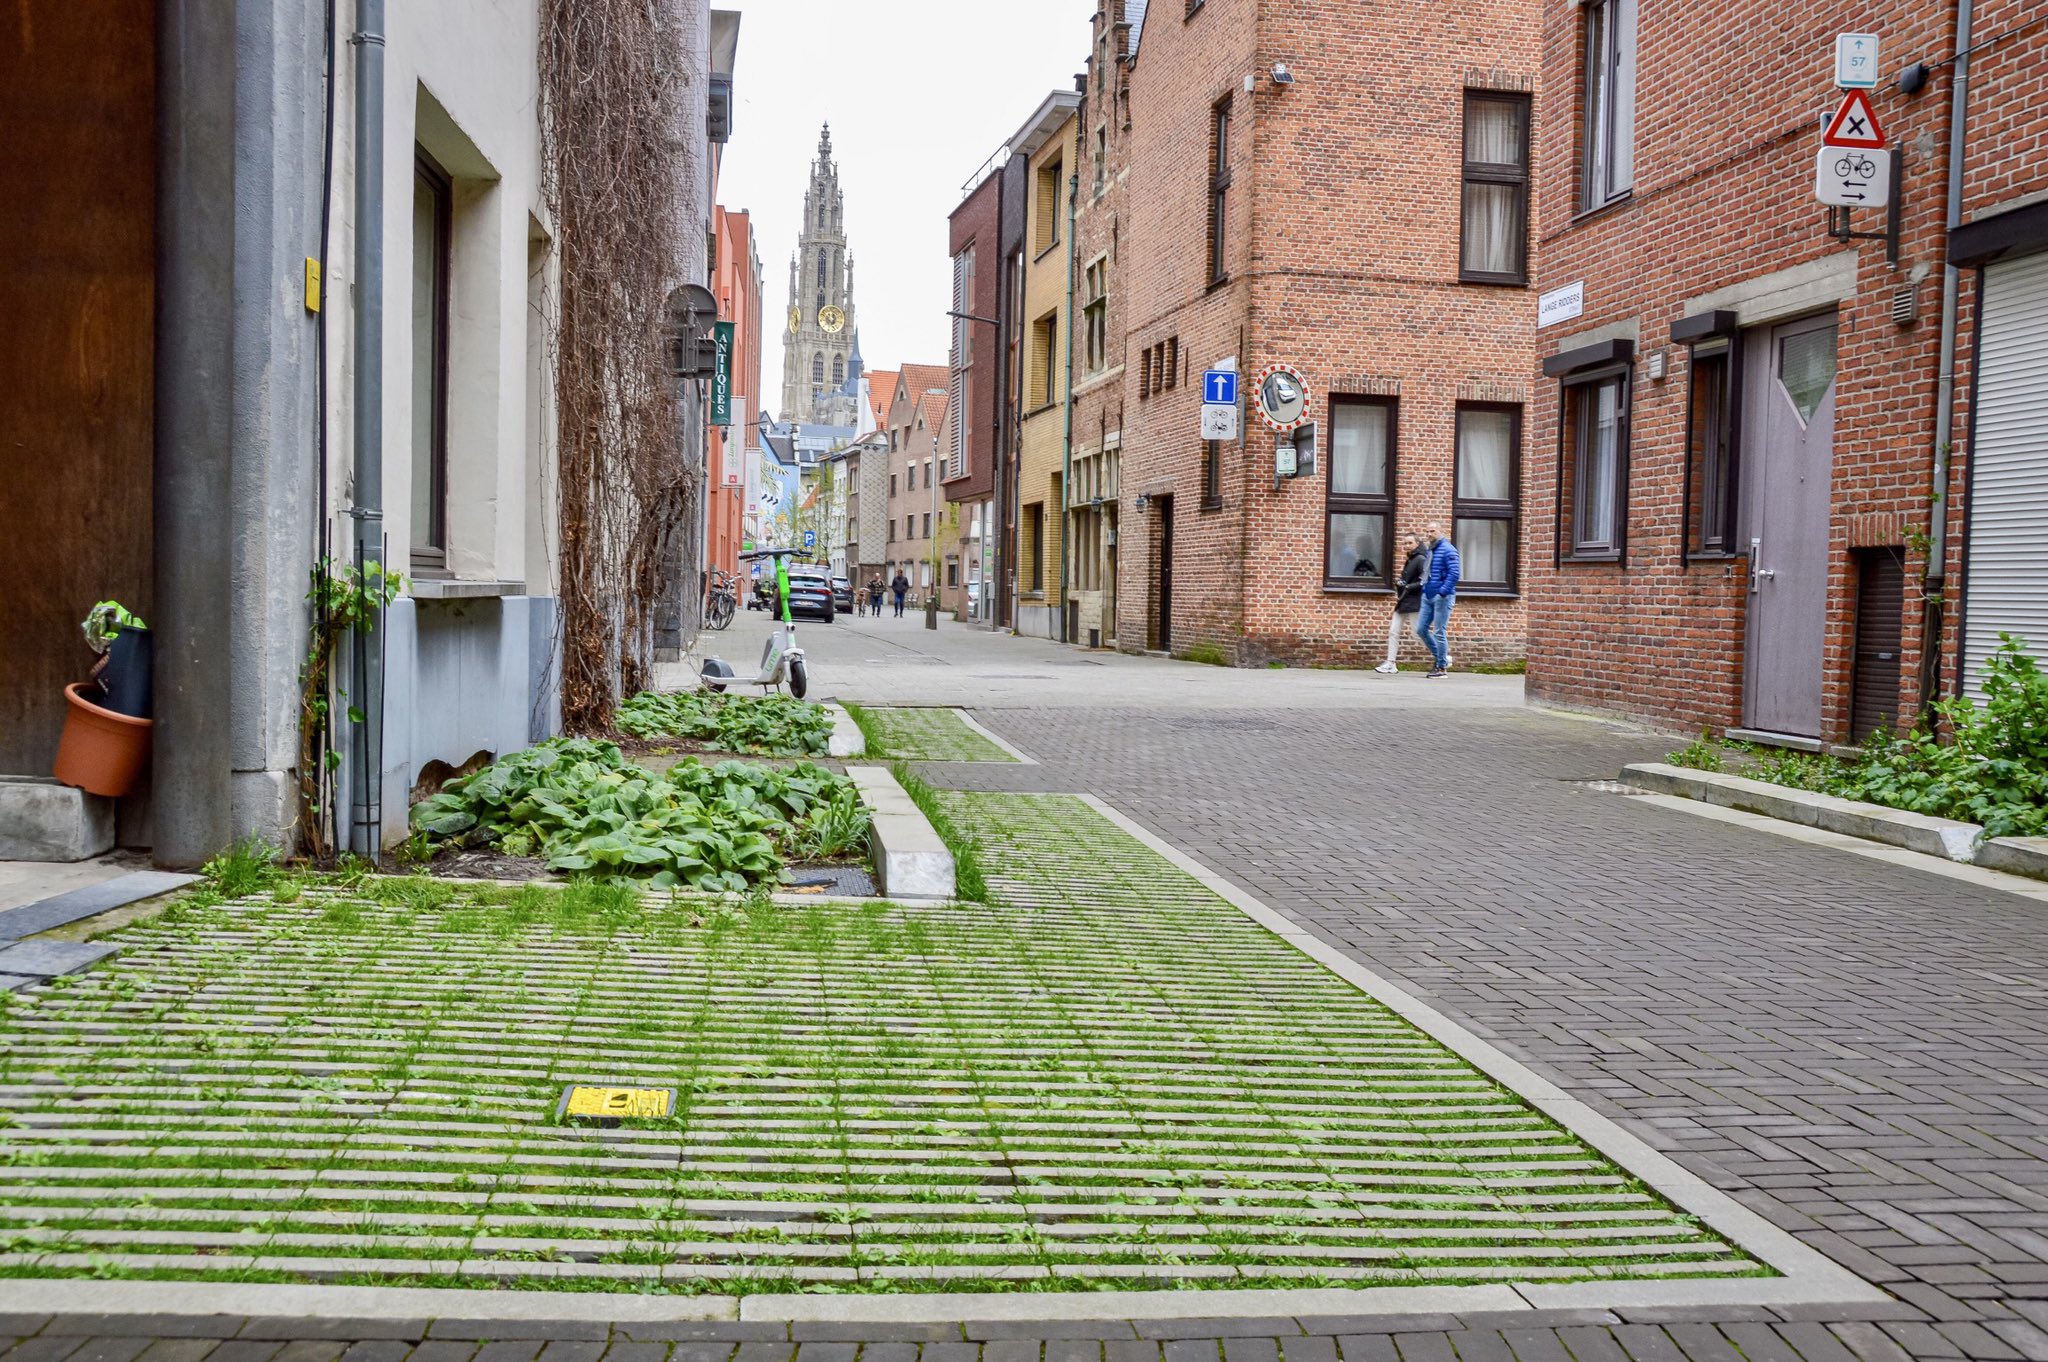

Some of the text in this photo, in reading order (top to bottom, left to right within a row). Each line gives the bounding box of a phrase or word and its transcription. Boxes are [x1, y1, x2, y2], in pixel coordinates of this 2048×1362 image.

[1851, 56, 1866, 66] 57
[1541, 300, 1557, 314] LANGE
[1558, 292, 1580, 307] RIDDERS
[717, 334, 728, 414] ANTIQUES
[805, 533, 813, 544] P
